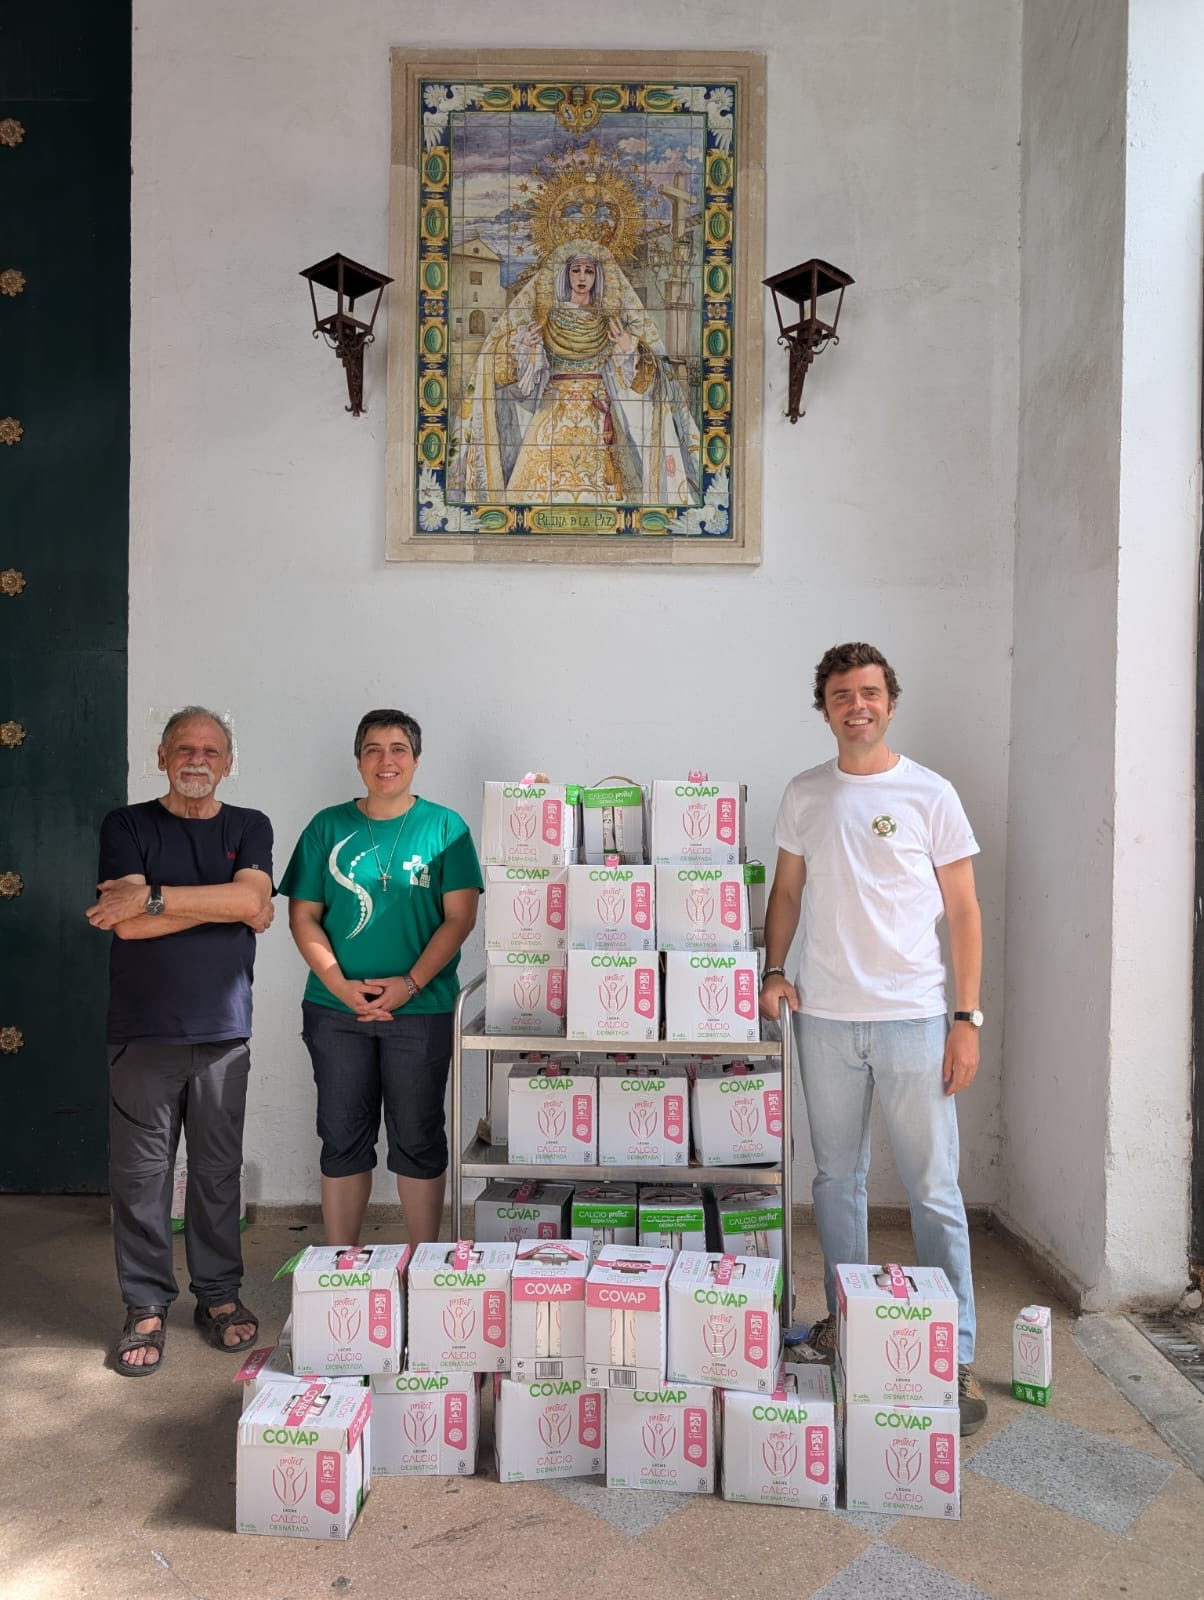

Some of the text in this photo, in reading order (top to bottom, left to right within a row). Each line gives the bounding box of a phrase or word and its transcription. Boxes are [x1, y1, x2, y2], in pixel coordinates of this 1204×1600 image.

[579, 517, 589, 526] LA
[503, 787, 546, 799] COVAP
[675, 786, 719, 797] COVAP
[508, 847, 537, 855] CALCIO
[682, 847, 711, 855] CALCIO
[506, 869, 550, 880] COVAP
[589, 871, 633, 882] COVAP
[678, 870, 722, 881] COVAP
[512, 932, 541, 940] CALCIO
[596, 933, 626, 941] CALCIO
[507, 953, 550, 965] COVAP
[591, 956, 637, 969] COVAP
[690, 956, 736, 969] COVAP
[512, 1017, 541, 1025] CALCIO
[597, 1021, 629, 1029] CALCIO
[698, 1022, 730, 1031] CALCIO
[529, 1078, 574, 1090] COVAP
[621, 1080, 666, 1092] COVAP
[720, 1079, 765, 1093] COVAP
[536, 1145, 567, 1153] CALCIO
[628, 1145, 659, 1154] CALCIO
[732, 1143, 763, 1152] CALCIO
[497, 1207, 540, 1221] COVAP
[647, 1214, 675, 1222] CALCIO
[729, 1217, 757, 1225] CALCIO
[318, 1272, 371, 1288] COVAP
[434, 1274, 486, 1288] COVAP
[524, 1283, 572, 1295] COVAP
[599, 1290, 646, 1304] COVAP
[694, 1290, 748, 1307] COVAP
[876, 1305, 932, 1321] COVAP
[893, 1328, 918, 1337] protect
[327, 1351, 362, 1361] CALCIO
[442, 1351, 476, 1360] CALCIO
[701, 1365, 738, 1377] CALCIO
[396, 1376, 449, 1391] COVAP
[530, 1380, 582, 1398] COVAP
[884, 1383, 923, 1393] CALCIO
[633, 1389, 687, 1404] COVAP
[545, 1403, 568, 1414] protect
[649, 1414, 671, 1424] protect
[752, 1406, 807, 1424] COVAP
[875, 1412, 932, 1431] COVAP
[263, 1429, 319, 1445] COVAP
[892, 1437, 918, 1448] protect
[280, 1456, 305, 1466] protect
[402, 1454, 438, 1463] CALCIO
[537, 1455, 572, 1466] CALCIO
[641, 1468, 677, 1478] CALCIO
[761, 1485, 799, 1496] CALCIO
[884, 1492, 923, 1503] CALCIO
[270, 1514, 309, 1524] CALCIO
